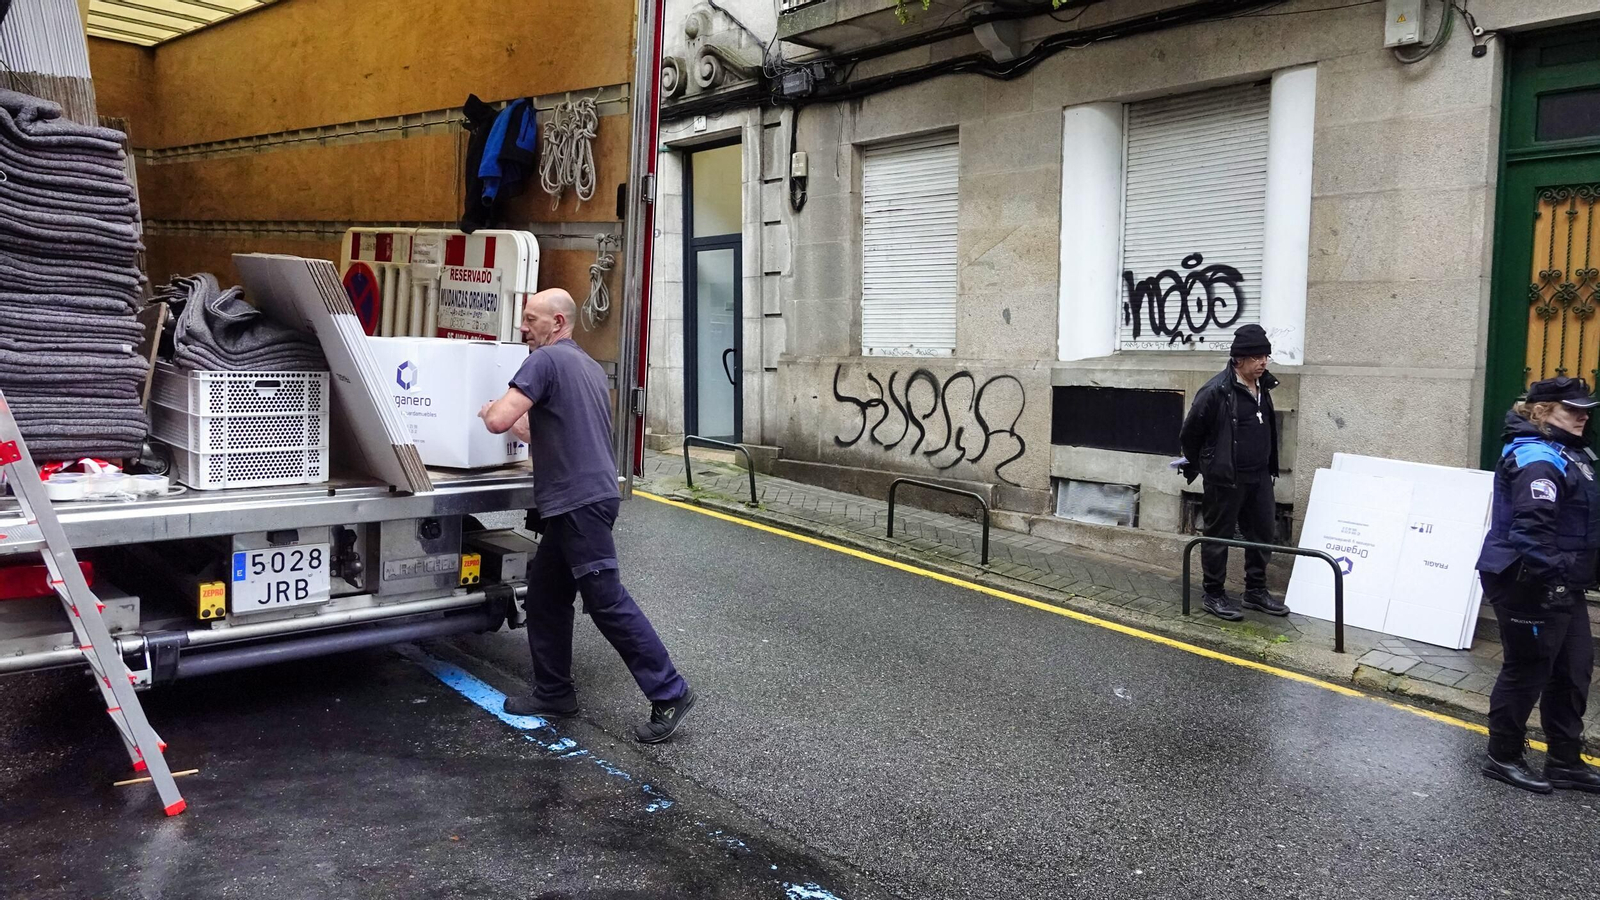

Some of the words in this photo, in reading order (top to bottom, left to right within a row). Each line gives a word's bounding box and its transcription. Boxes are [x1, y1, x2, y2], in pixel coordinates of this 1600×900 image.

[450, 268, 492, 284] RESERVADO
[440, 288, 468, 308] MUDANZAS
[468, 291, 498, 312] ORGANERO
[393, 395, 432, 408] ganero
[1325, 542, 1369, 559] Organero
[251, 548, 322, 576] 5028
[463, 559, 480, 568] ZEPRO
[1423, 560, 1449, 570] FRAGIL
[202, 588, 225, 598] ZEPRO
[258, 578, 310, 605] JRB
